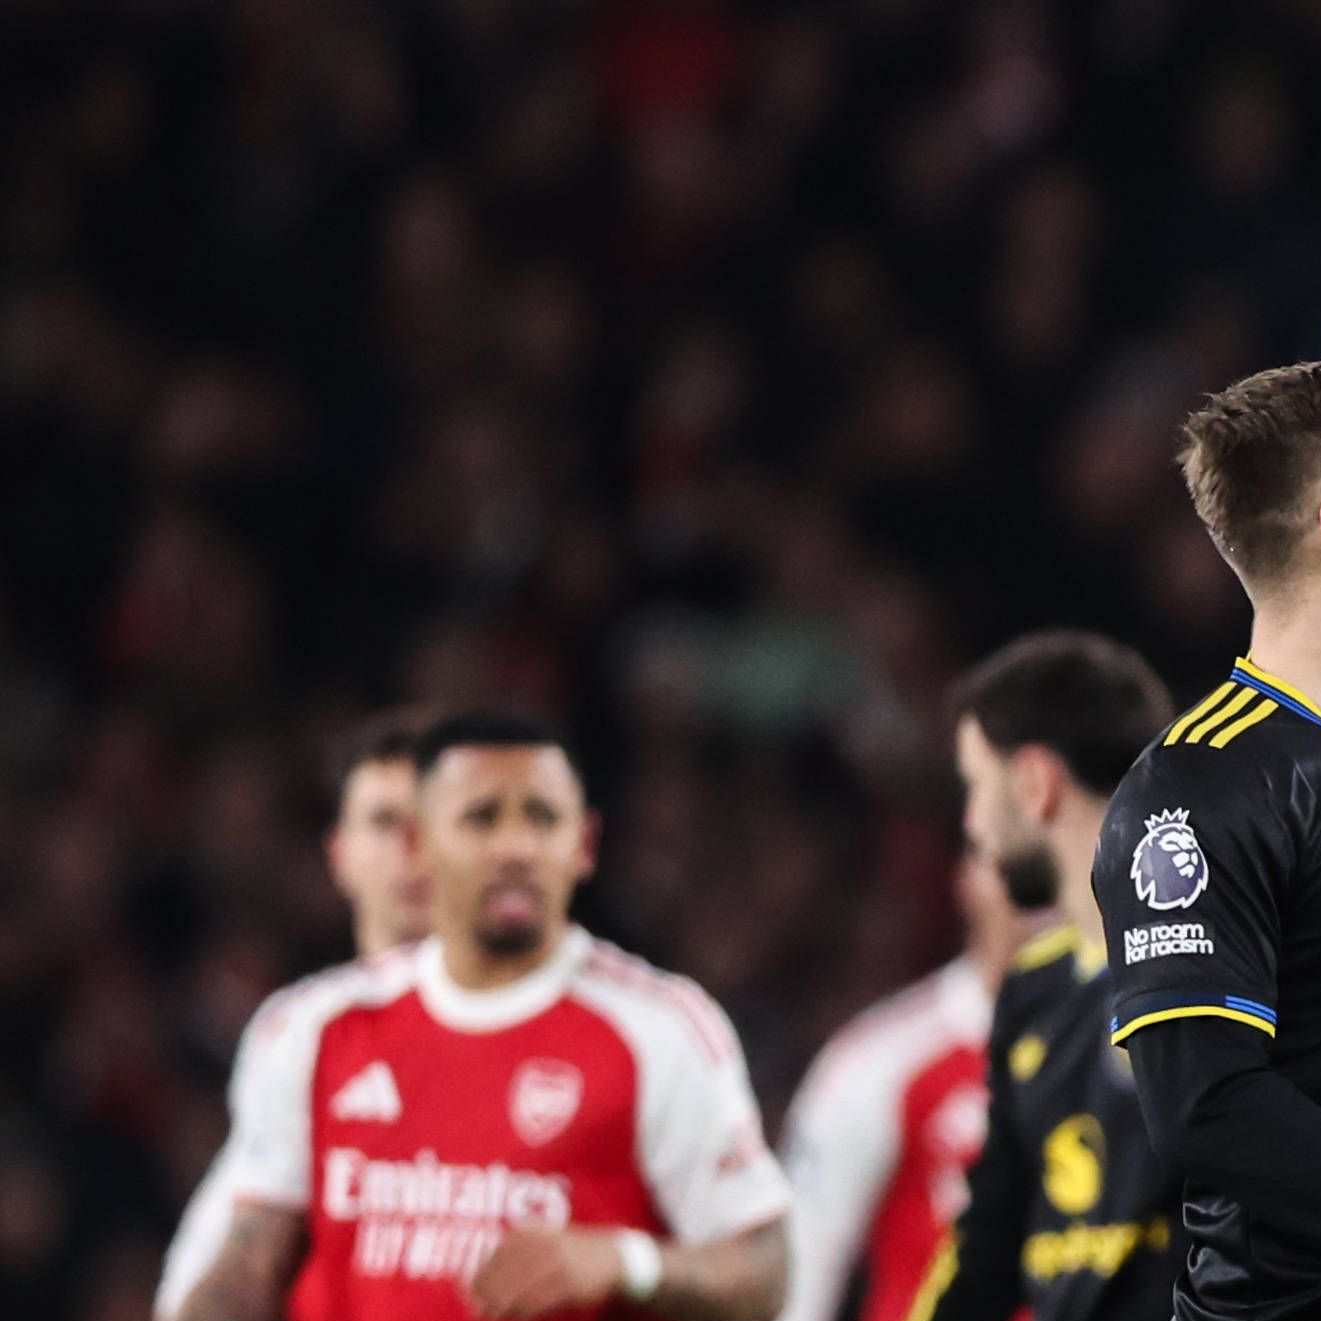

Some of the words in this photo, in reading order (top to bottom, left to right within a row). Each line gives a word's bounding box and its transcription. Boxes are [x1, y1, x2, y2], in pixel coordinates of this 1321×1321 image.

[1123, 927, 1149, 947] No
[1150, 923, 1205, 942] room
[1125, 943, 1149, 966] for
[1150, 938, 1214, 958] racism
